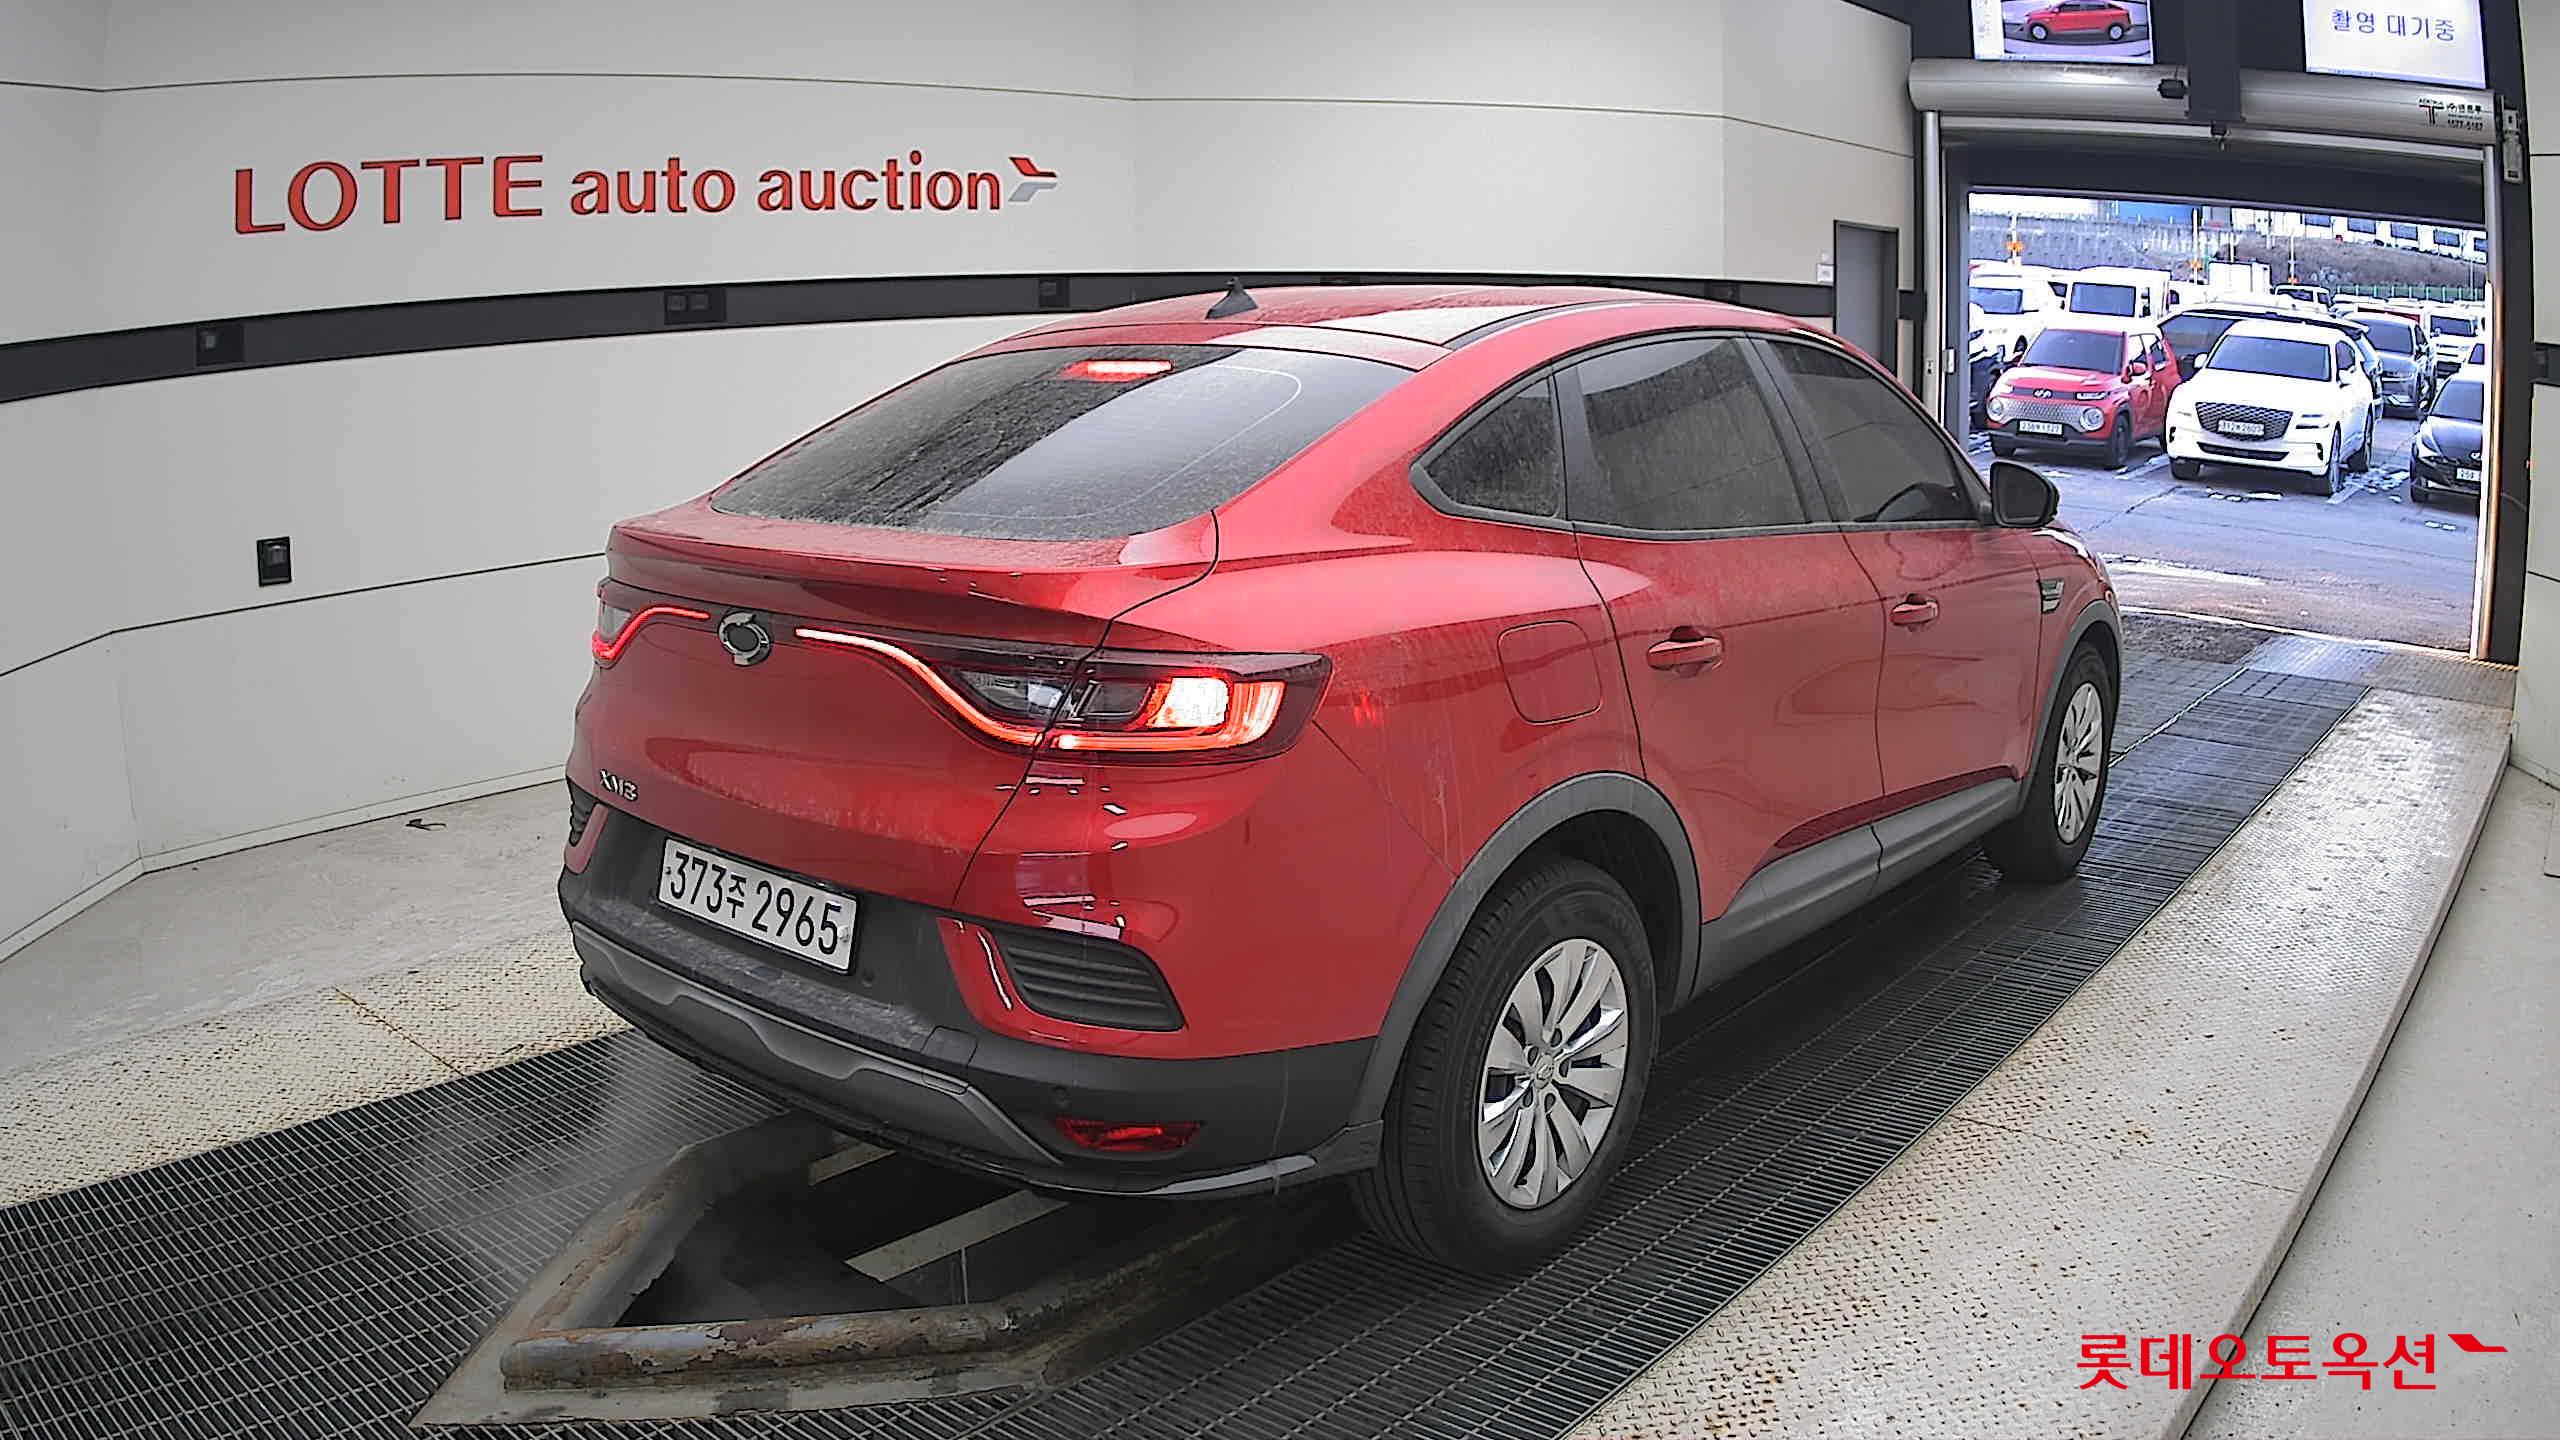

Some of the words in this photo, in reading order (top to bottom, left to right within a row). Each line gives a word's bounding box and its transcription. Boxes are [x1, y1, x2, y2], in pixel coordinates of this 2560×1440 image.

[2331, 8, 2375, 34] 촬영
[2386, 14, 2455, 41] 대기중
[235, 154, 541, 235] LOTTE
[570, 157, 738, 215] auto
[756, 151, 1003, 211] auction
[670, 851, 747, 919] 373주
[751, 880, 842, 955] 2965
